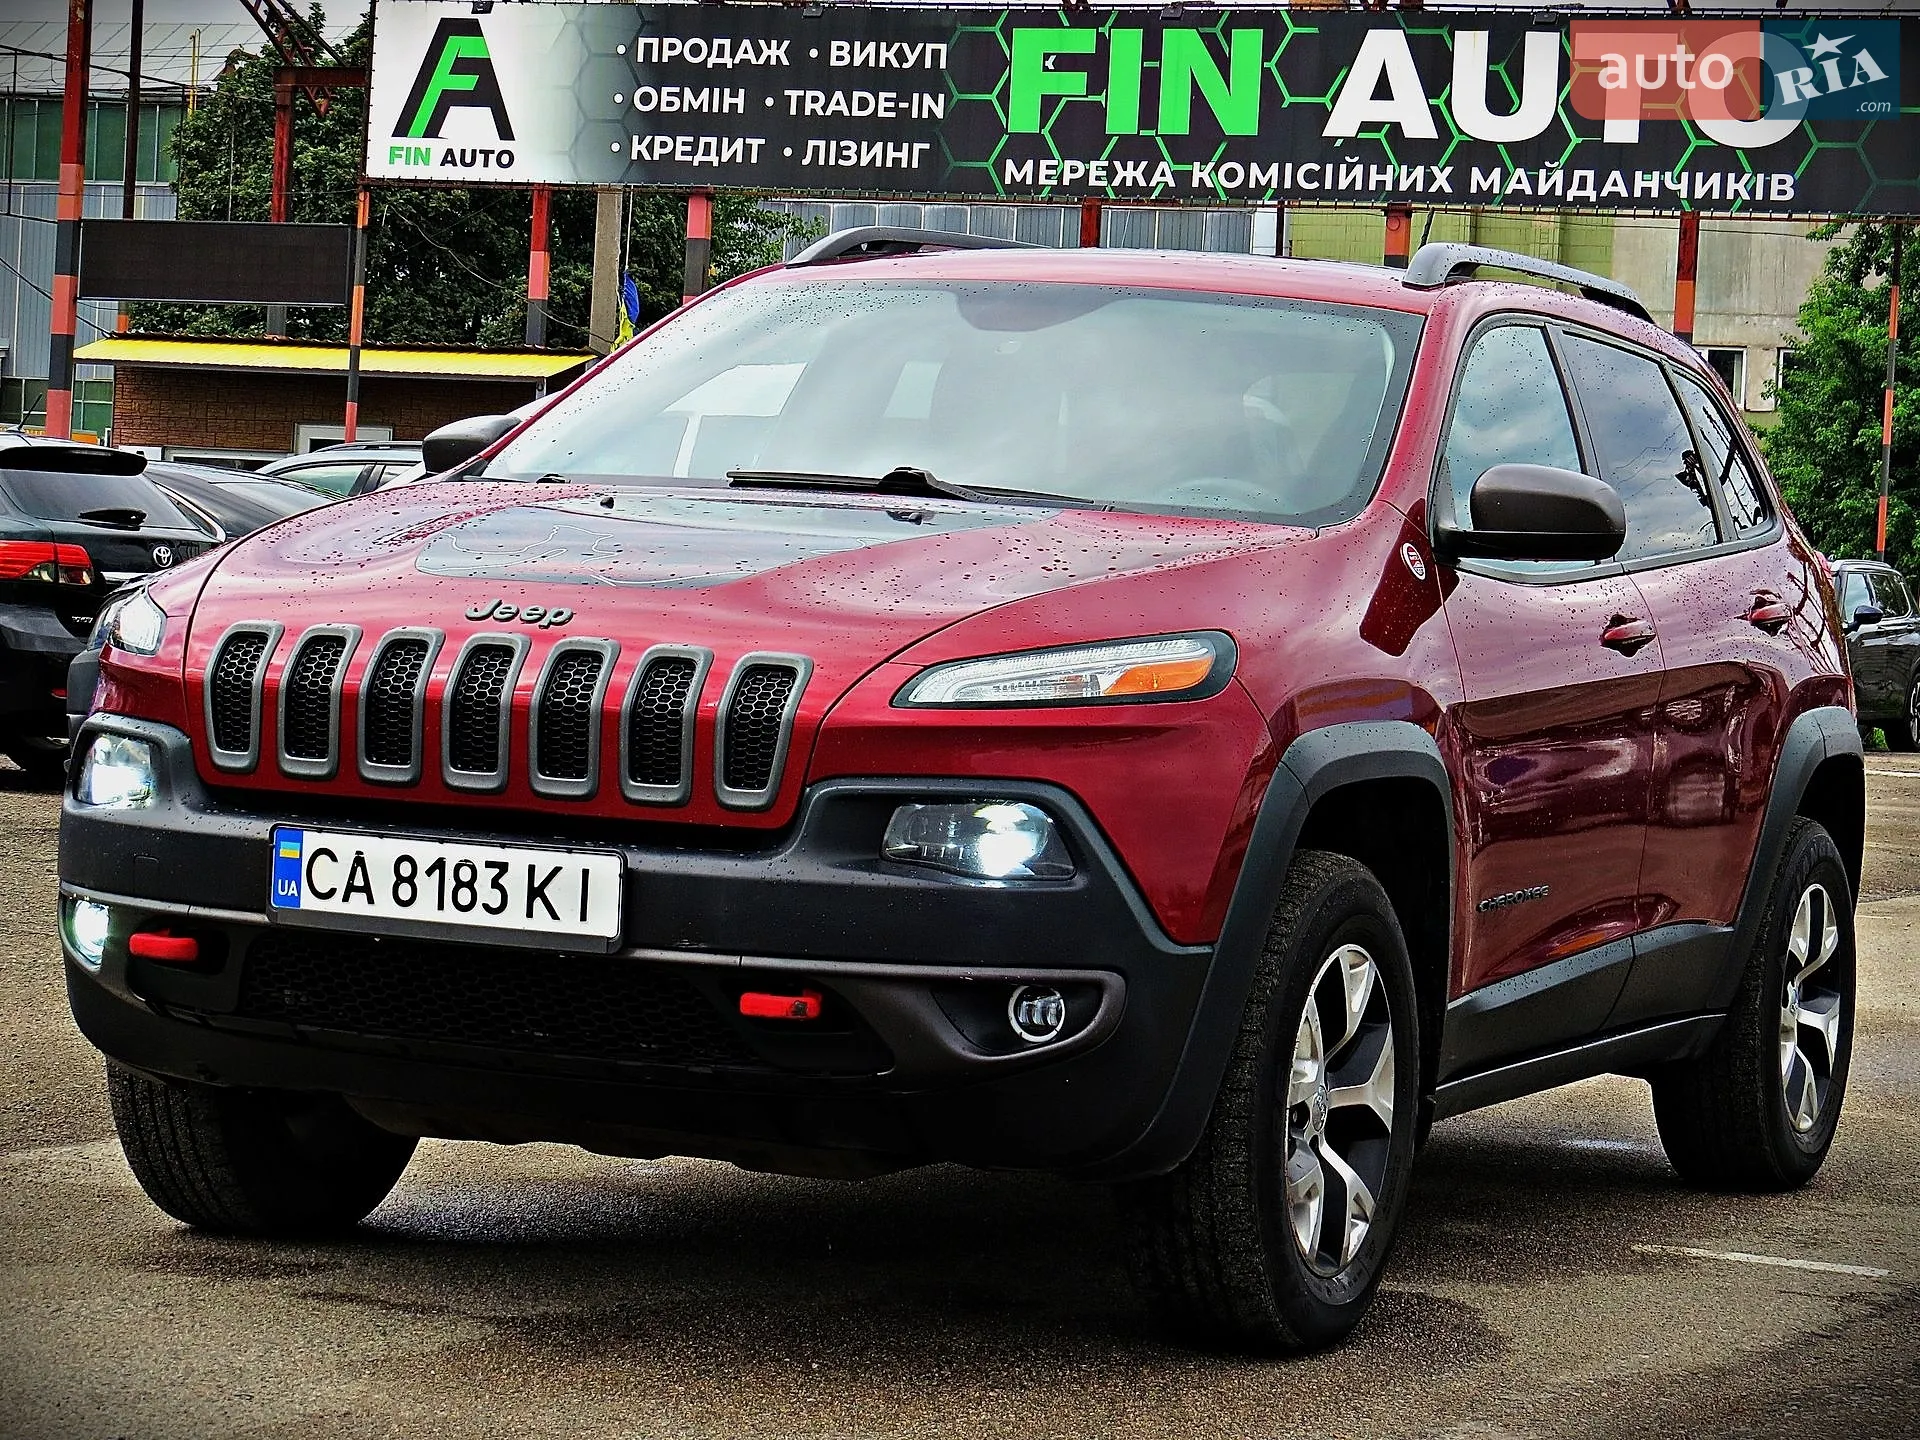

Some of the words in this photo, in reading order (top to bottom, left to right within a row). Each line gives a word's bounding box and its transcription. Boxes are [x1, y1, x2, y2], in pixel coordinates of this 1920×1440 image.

[635, 36, 791, 67] ПРОДАЖ
[829, 40, 948, 70] ВИКУП
[632, 85, 746, 115] ОБМІН
[784, 89, 946, 120] TRADE-IN
[1007, 27, 1264, 137] FIN
[1322, 29, 1812, 149] AUTO
[388, 146, 432, 166] FIN
[440, 148, 515, 169] AUTO
[630, 134, 767, 167] КРЕДИТ
[801, 139, 931, 169] ЛІЗИНГ
[1004, 158, 1177, 189] МЕРЕЖА
[1192, 156, 1455, 194] КОМІСІЙНИХ
[1470, 161, 1796, 202] МАЙДАНЧИКІВ
[465, 598, 574, 629] Jeep
[278, 879, 299, 898] UA
[306, 847, 375, 905] CA
[391, 854, 509, 915] 8183
[525, 864, 591, 923] KI
